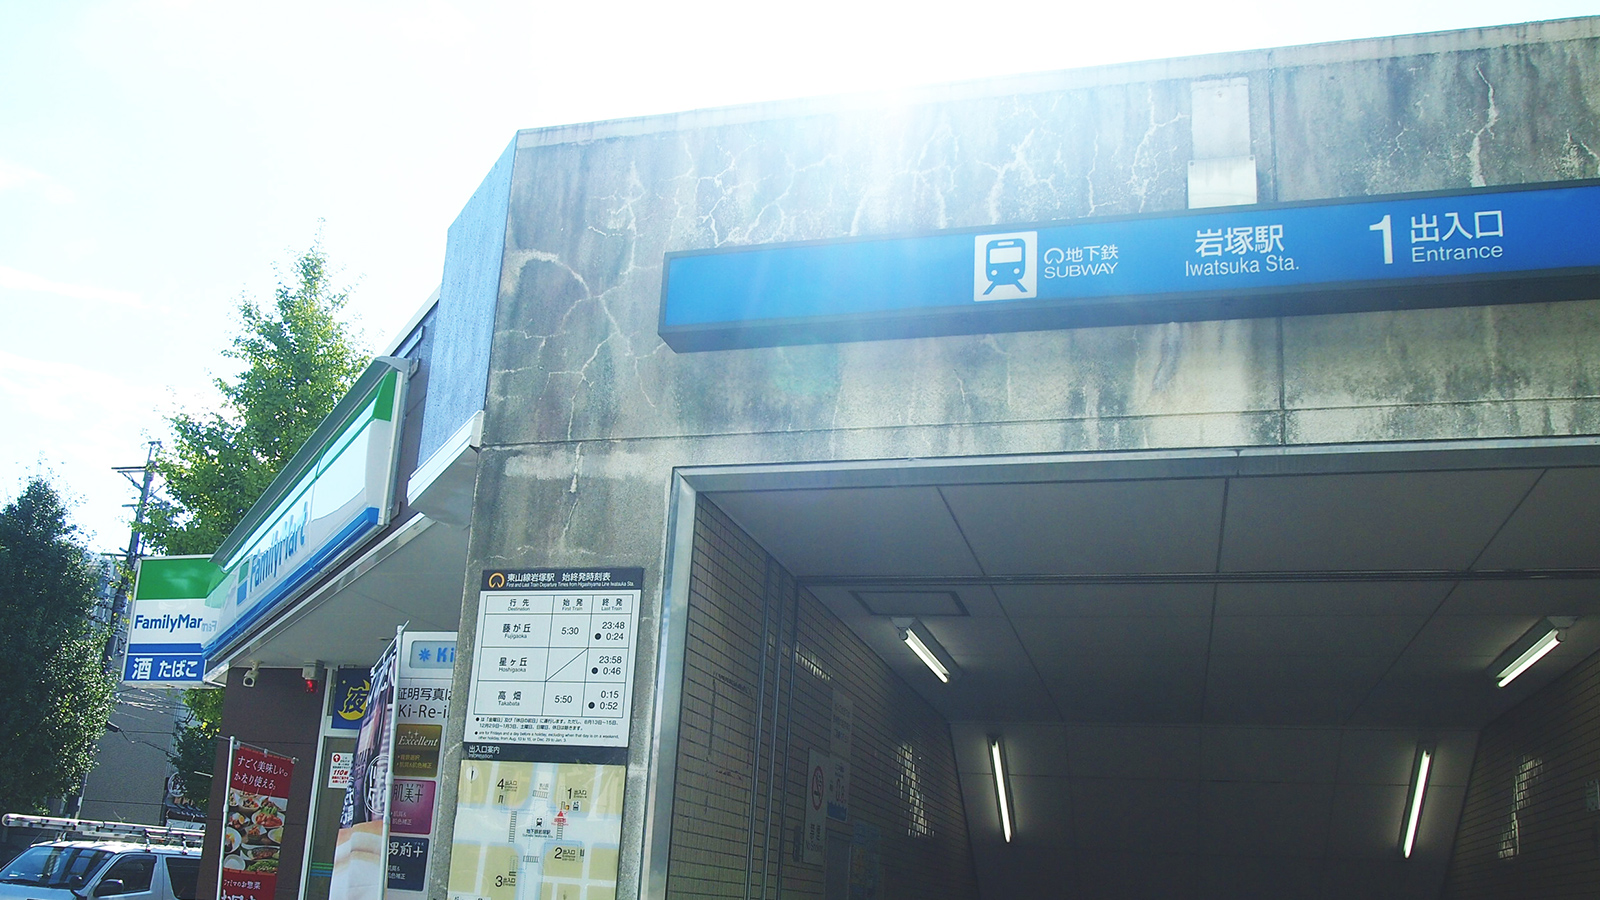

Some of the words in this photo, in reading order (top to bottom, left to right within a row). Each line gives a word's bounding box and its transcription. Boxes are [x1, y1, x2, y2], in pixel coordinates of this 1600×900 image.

[1195, 224, 1285, 257] 岩塚駅
[1369, 214, 1393, 264] 1
[1411, 210, 1504, 244] 出入口
[1065, 244, 1119, 263] 地下鉄
[1412, 245, 1504, 263] Entrance
[1044, 262, 1119, 279] SUBWAY
[1185, 257, 1260, 277] Iwatsuka
[1266, 255, 1300, 272] Sta.
[507, 573, 555, 582] 東山線岩塚駅
[561, 572, 611, 581] 始終発時刻表
[502, 623, 531, 632] 藤が丘
[561, 626, 579, 635] 5:30
[602, 621, 625, 629] 23:48
[606, 632, 624, 640] 0:24
[599, 656, 622, 664] 23:58
[132, 658, 153, 680] 酒
[158, 660, 198, 678] たばこ
[603, 667, 621, 675] 0:46
[554, 695, 573, 703] 5:50
[601, 690, 619, 698] 0:15
[398, 704, 449, 718] Ki-Re-i
[600, 702, 618, 710] 0:52
[398, 736, 438, 747] Excellent
[497, 778, 504, 789] 4
[567, 788, 572, 799] 1
[554, 847, 562, 859] 2
[495, 875, 502, 887] 3
